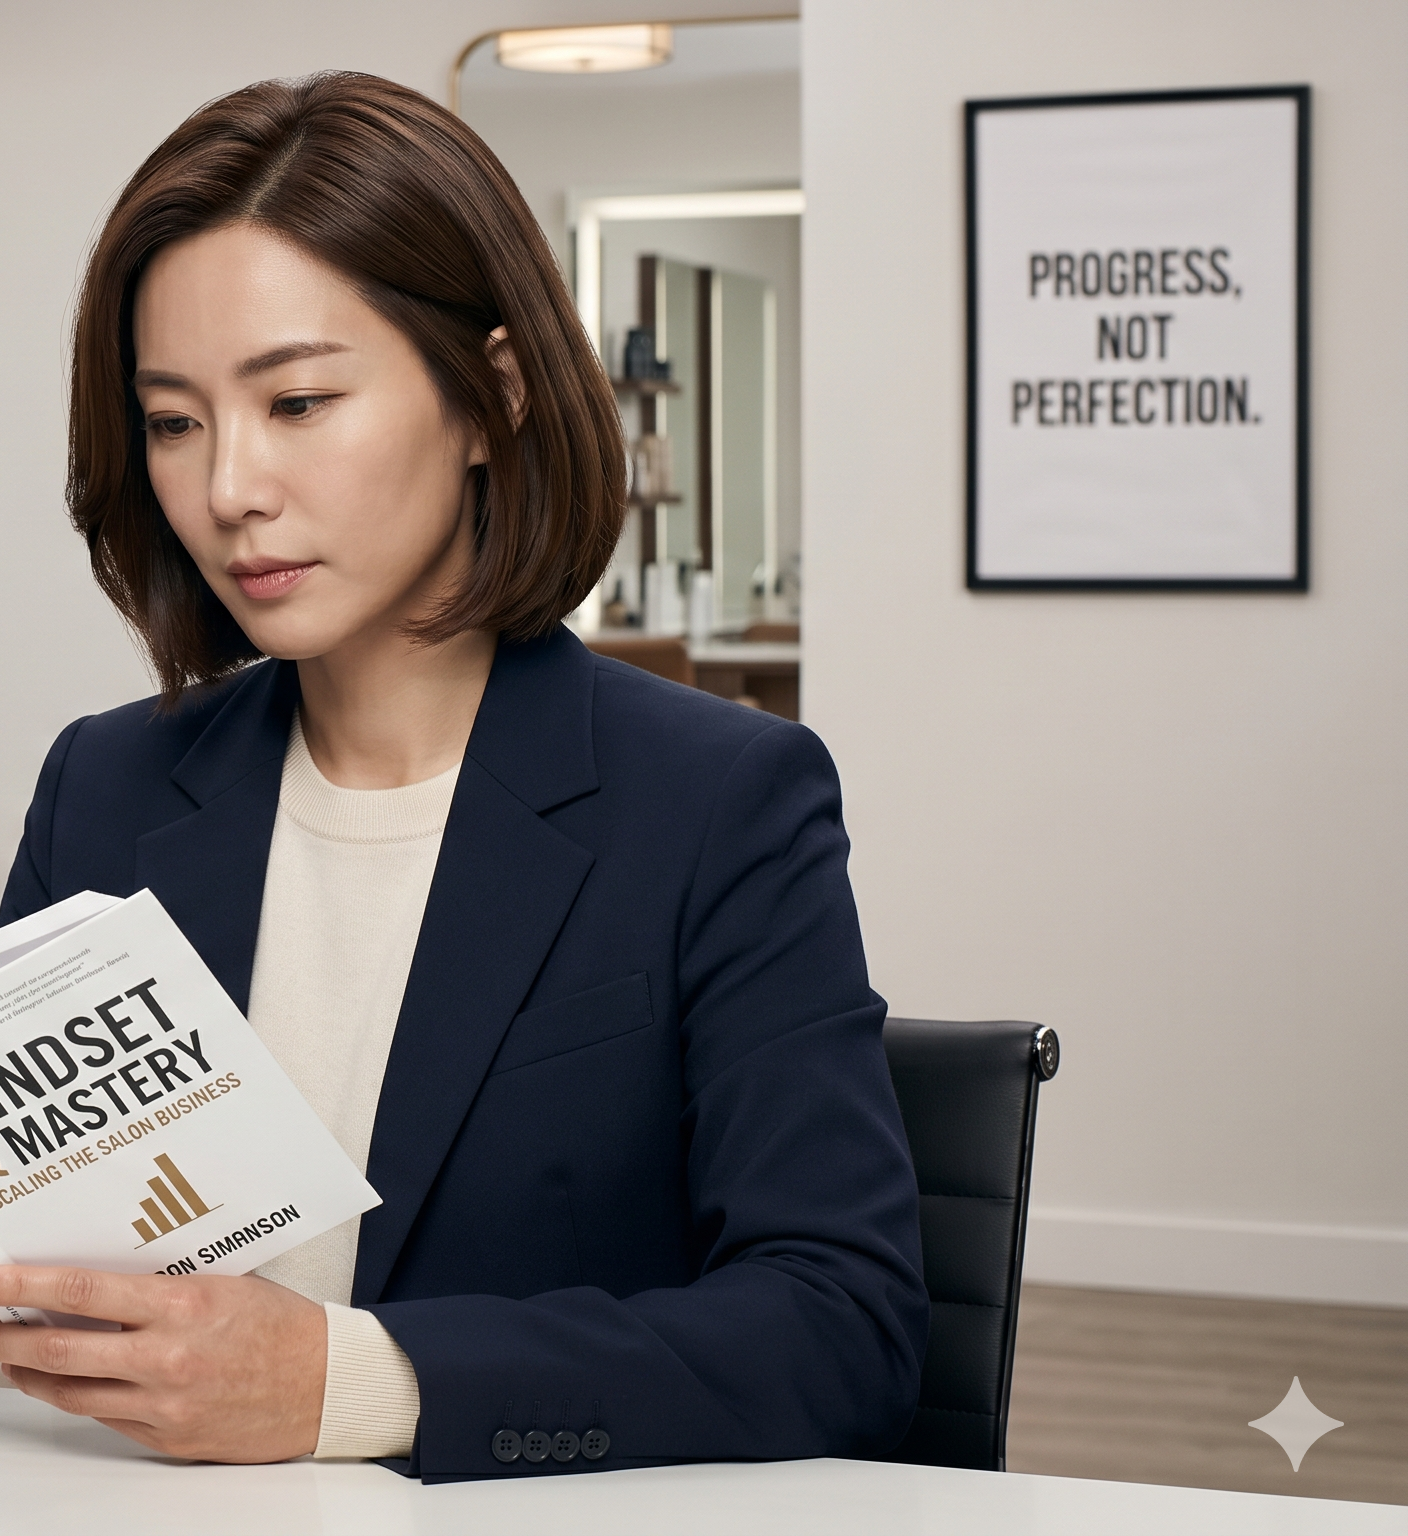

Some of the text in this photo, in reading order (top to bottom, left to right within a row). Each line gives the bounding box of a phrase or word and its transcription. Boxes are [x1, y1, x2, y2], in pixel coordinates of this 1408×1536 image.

[1028, 247, 1242, 300] PROGRESS,
[1096, 313, 1174, 361] NOT
[1012, 376, 1261, 426] PERFECTION.
[59, 1146, 99, 1173] THE
[96, 1117, 156, 1155] SALON
[153, 1072, 242, 1127] BUSINESS
[197, 1204, 301, 1264] SIMANSON
